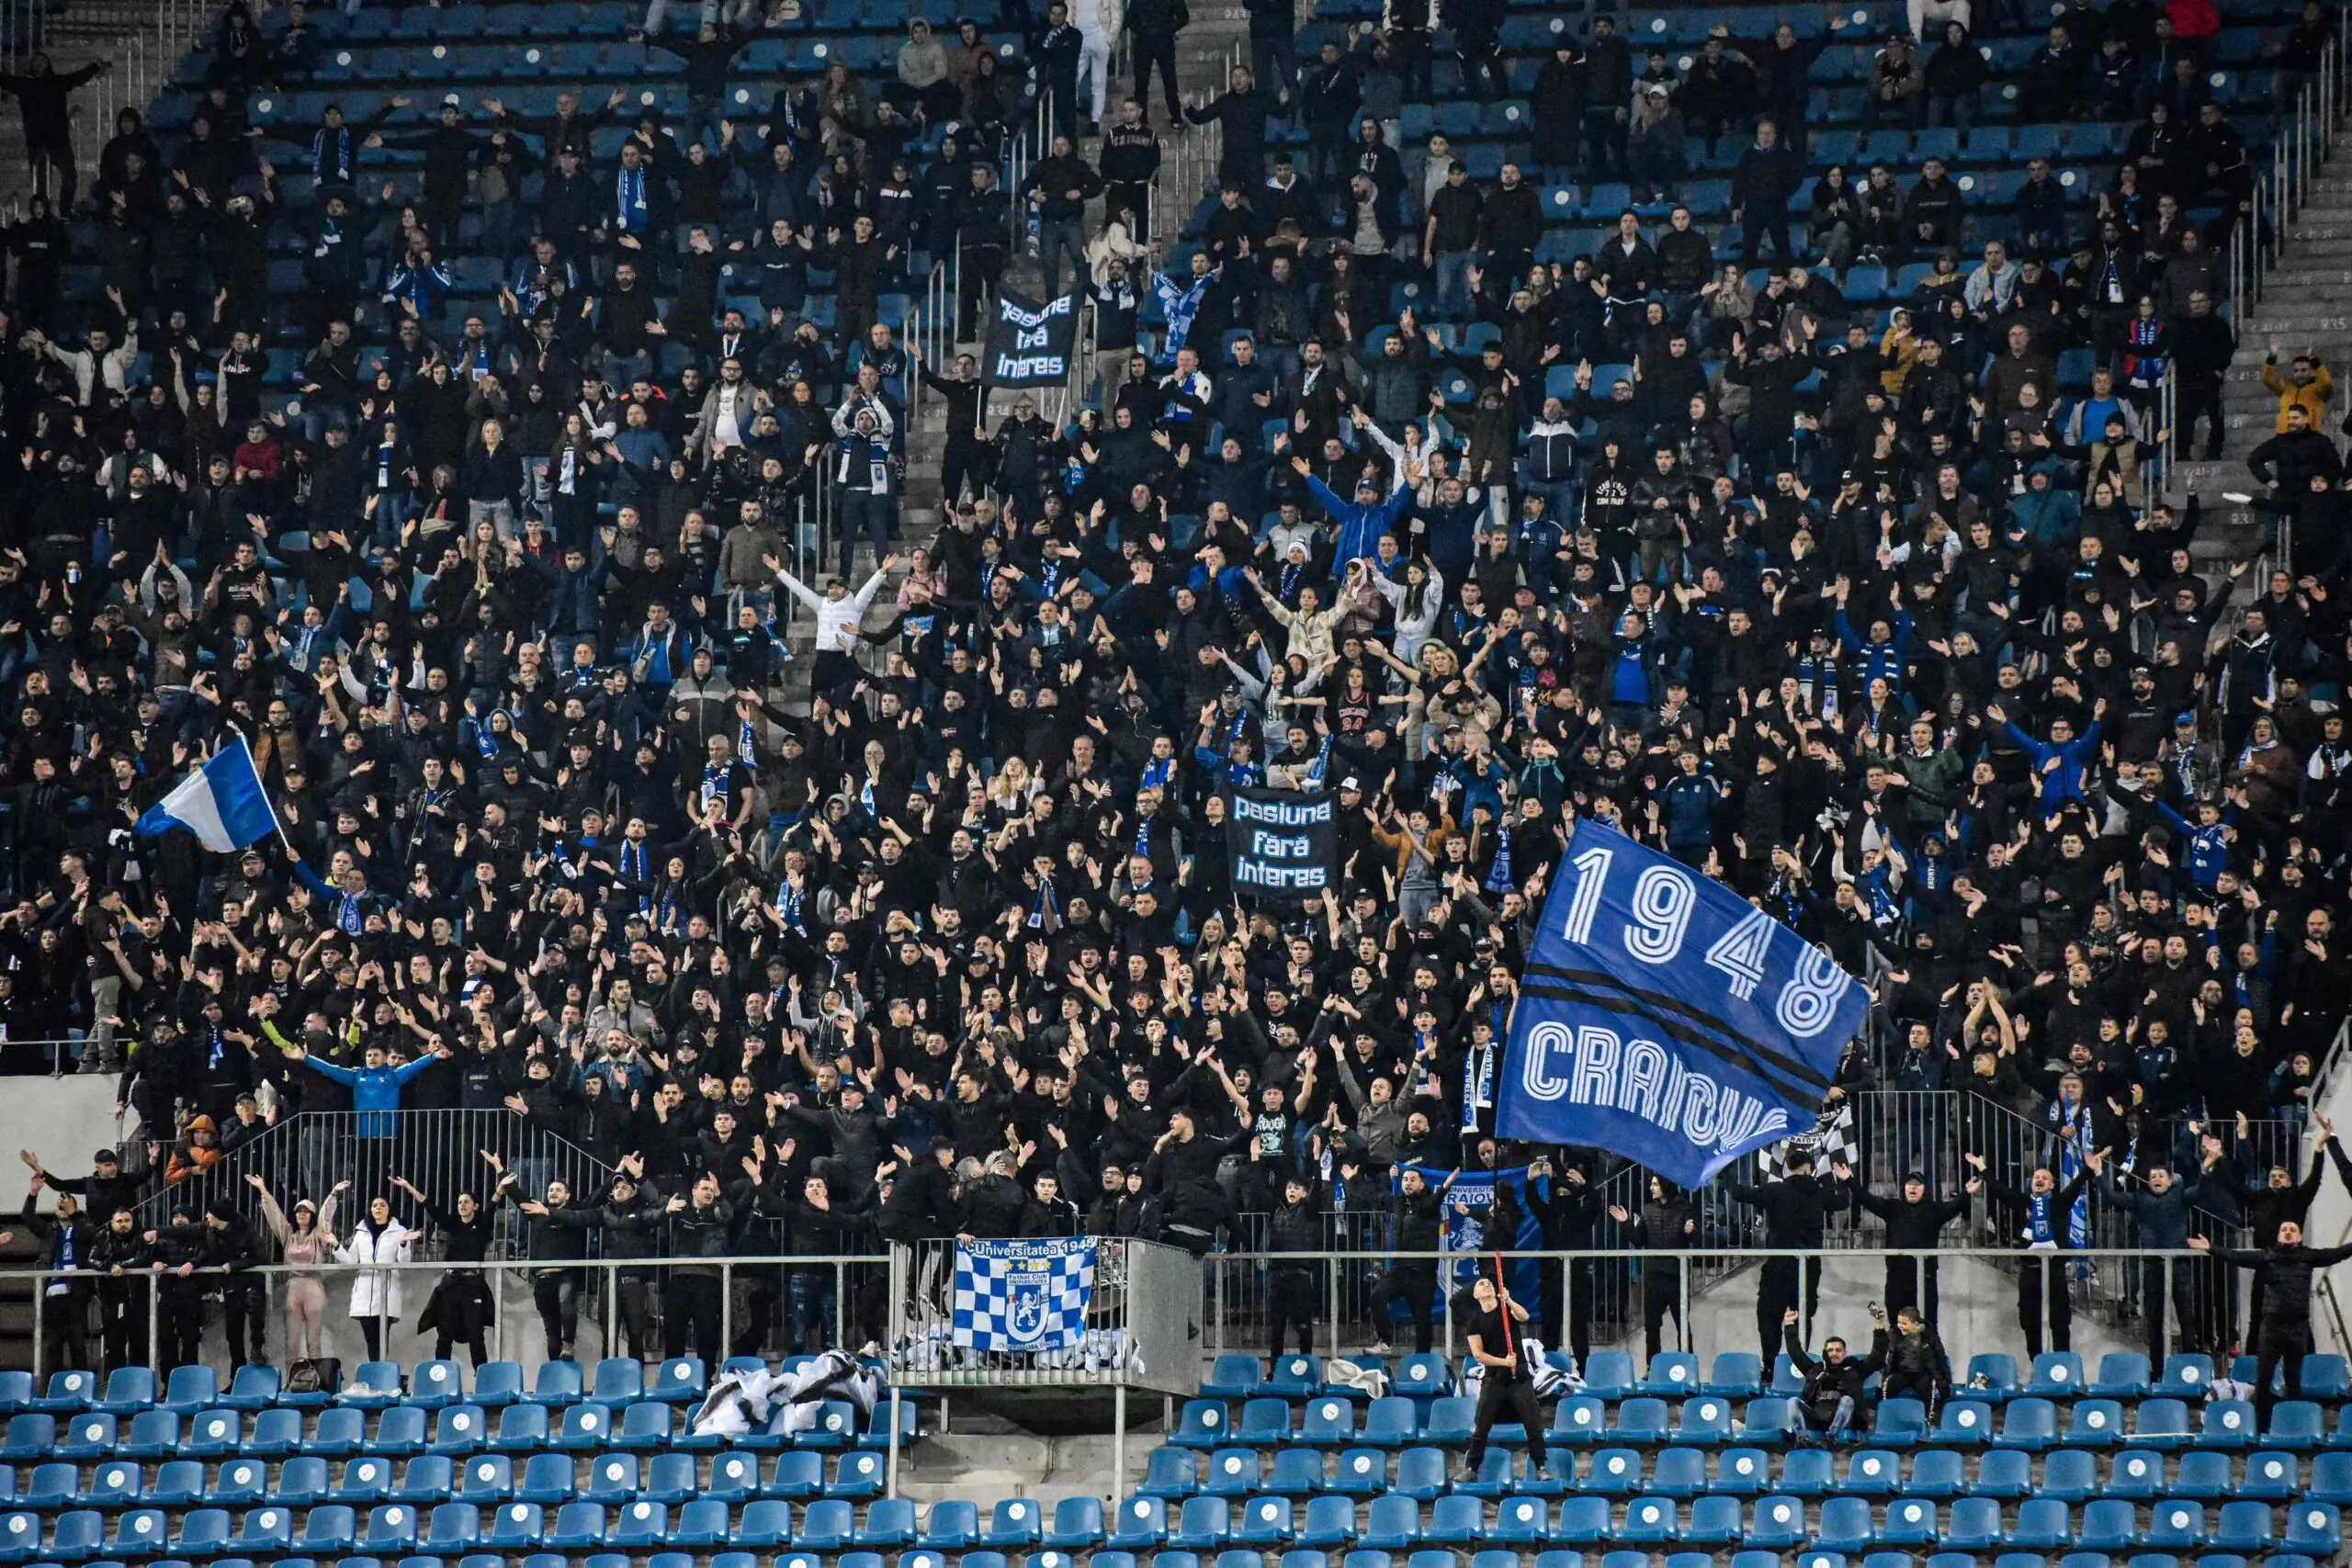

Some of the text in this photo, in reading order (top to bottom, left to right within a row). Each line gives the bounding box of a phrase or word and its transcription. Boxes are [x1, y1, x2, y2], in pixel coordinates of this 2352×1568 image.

[1001, 295, 1071, 327] pasune
[1234, 795, 1330, 825] pasiune
[1253, 830, 1311, 857] fără
[1237, 856, 1326, 886] interes
[1563, 846, 1852, 1038] 1948
[1786, 1135, 1822, 1144] RAIOVA
